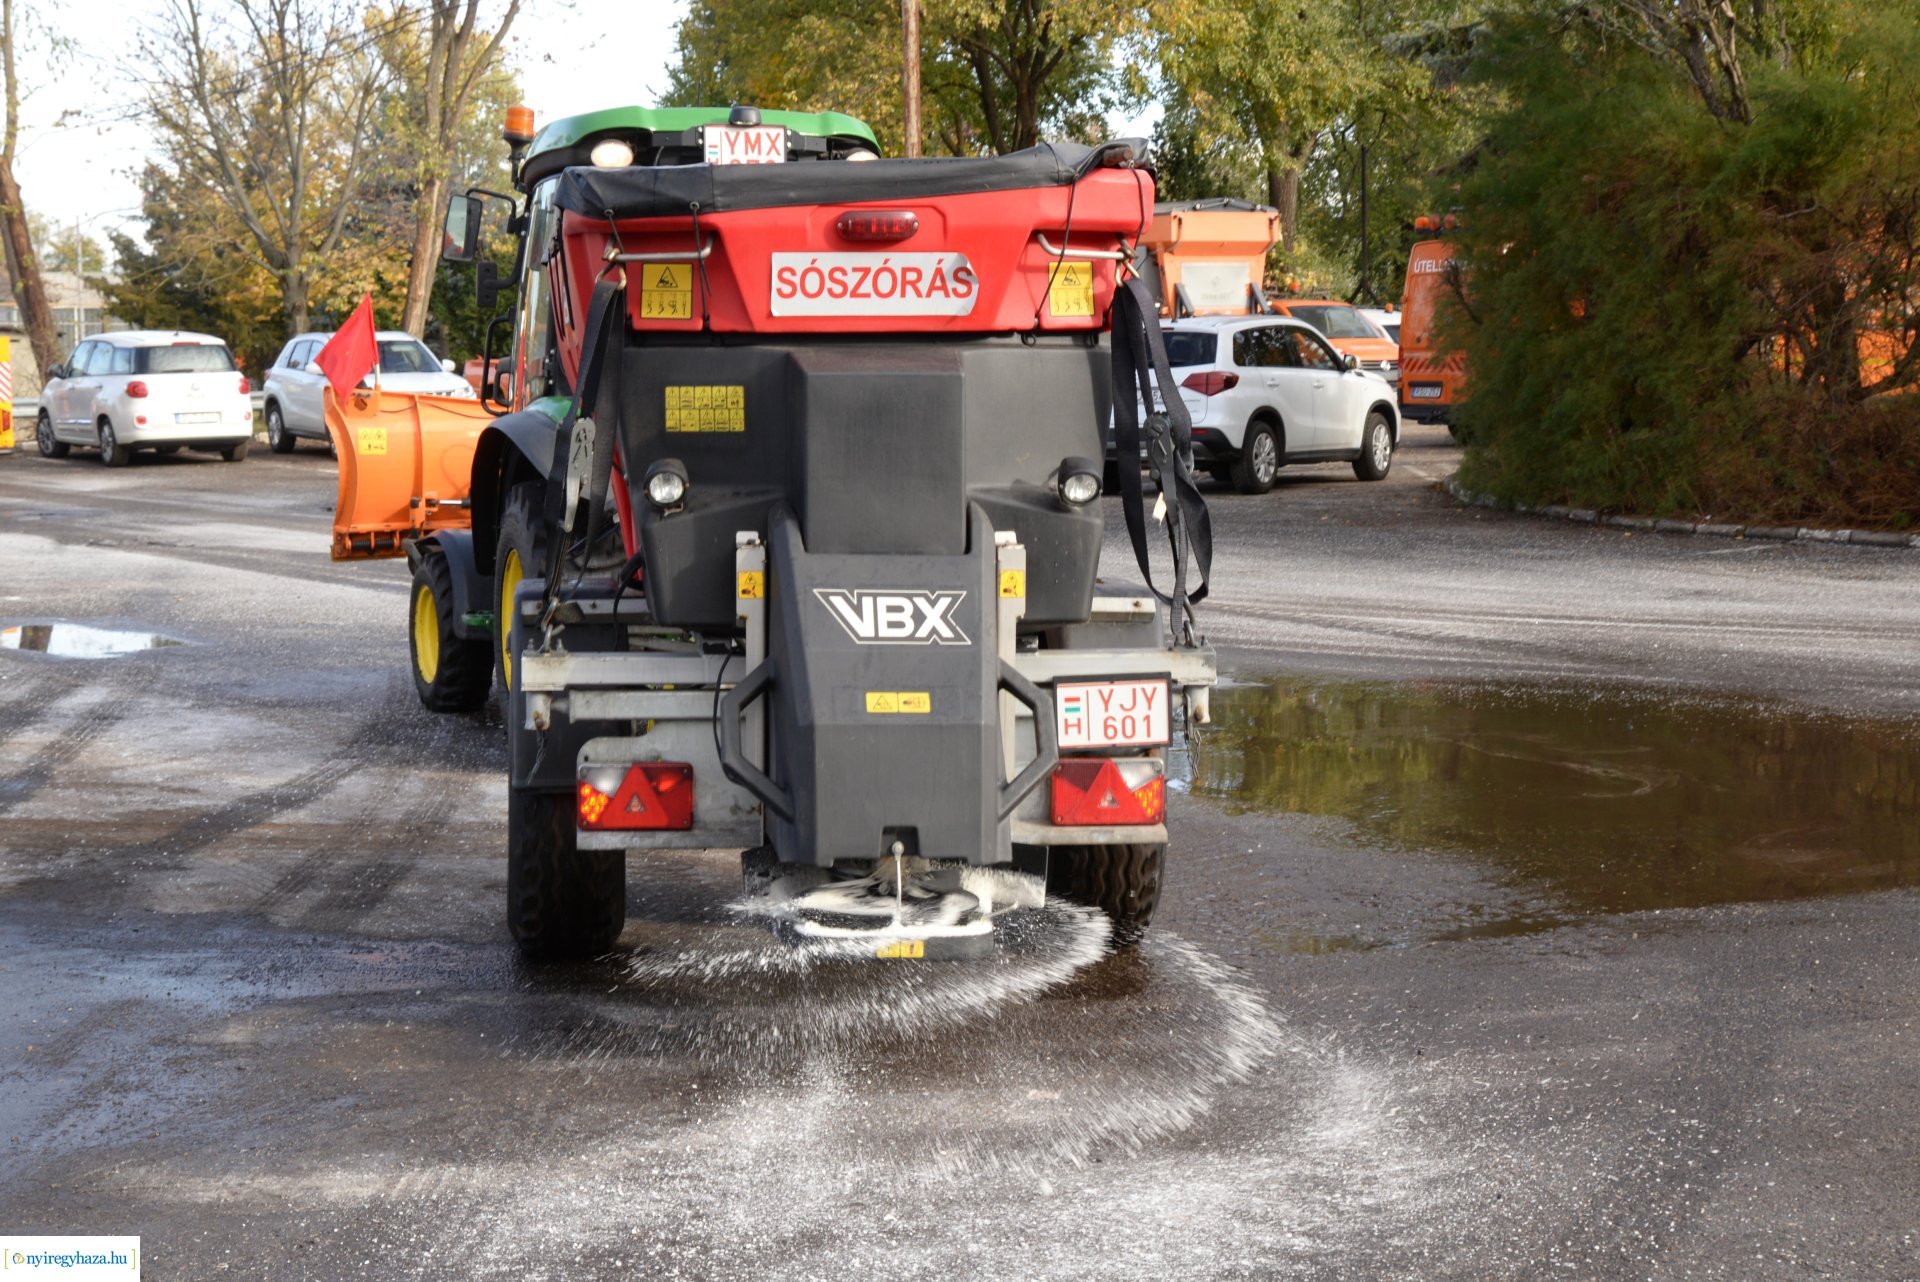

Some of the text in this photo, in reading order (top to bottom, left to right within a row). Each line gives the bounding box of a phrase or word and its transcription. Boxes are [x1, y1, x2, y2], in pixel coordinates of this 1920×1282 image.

[724, 131, 781, 156] YMX
[776, 258, 973, 299] SÓSZÓRÁS
[827, 595, 956, 638] VBX
[1098, 687, 1157, 712] YJY
[1064, 717, 1081, 735] H
[1103, 714, 1151, 740] 601
